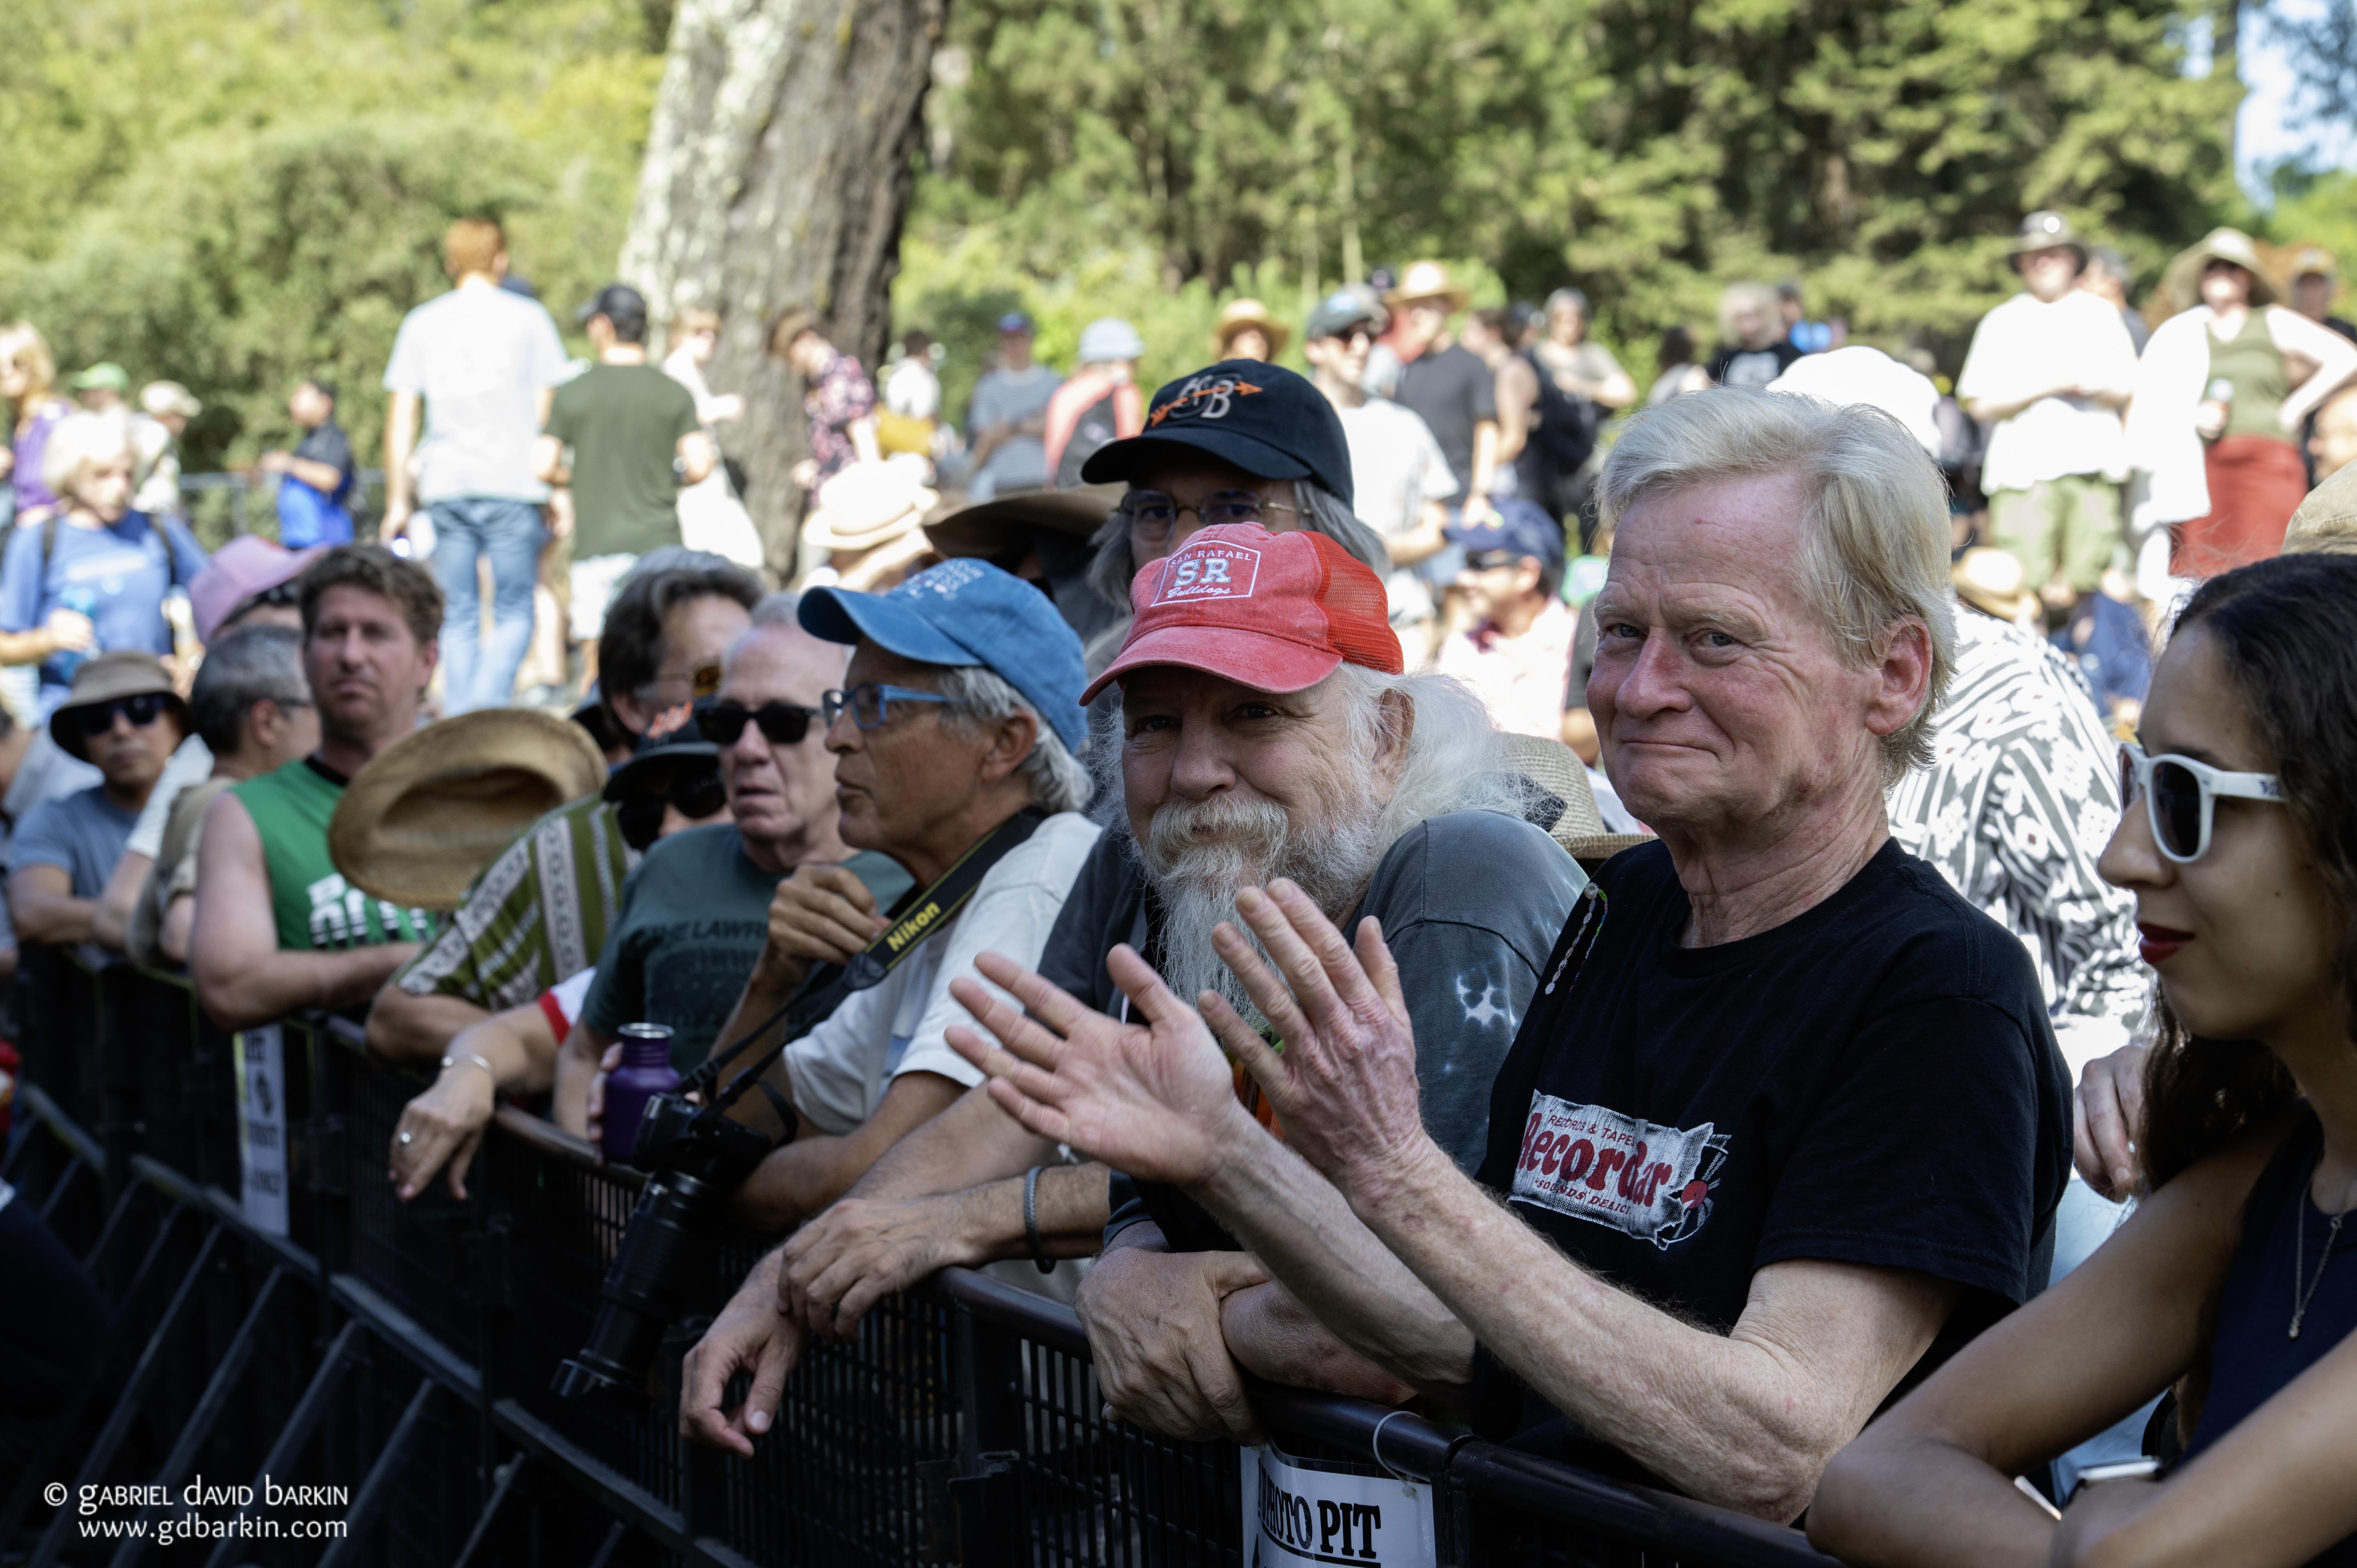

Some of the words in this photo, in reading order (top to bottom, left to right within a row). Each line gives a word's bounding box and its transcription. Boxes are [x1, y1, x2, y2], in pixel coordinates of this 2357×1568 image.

[1170, 553, 1191, 567] SAN
[1197, 549, 1251, 561] RAFAEL
[1173, 558, 1232, 586] SR
[1167, 585, 1232, 599] Bulldogs
[886, 901, 941, 952] Nikon
[1547, 1114, 1586, 1132] RECORDS
[1588, 1124, 1597, 1134] &
[1601, 1127, 1636, 1146] TAPES
[1266, 1474, 1313, 1550] PHOTO
[1317, 1499, 1381, 1559] PIT
